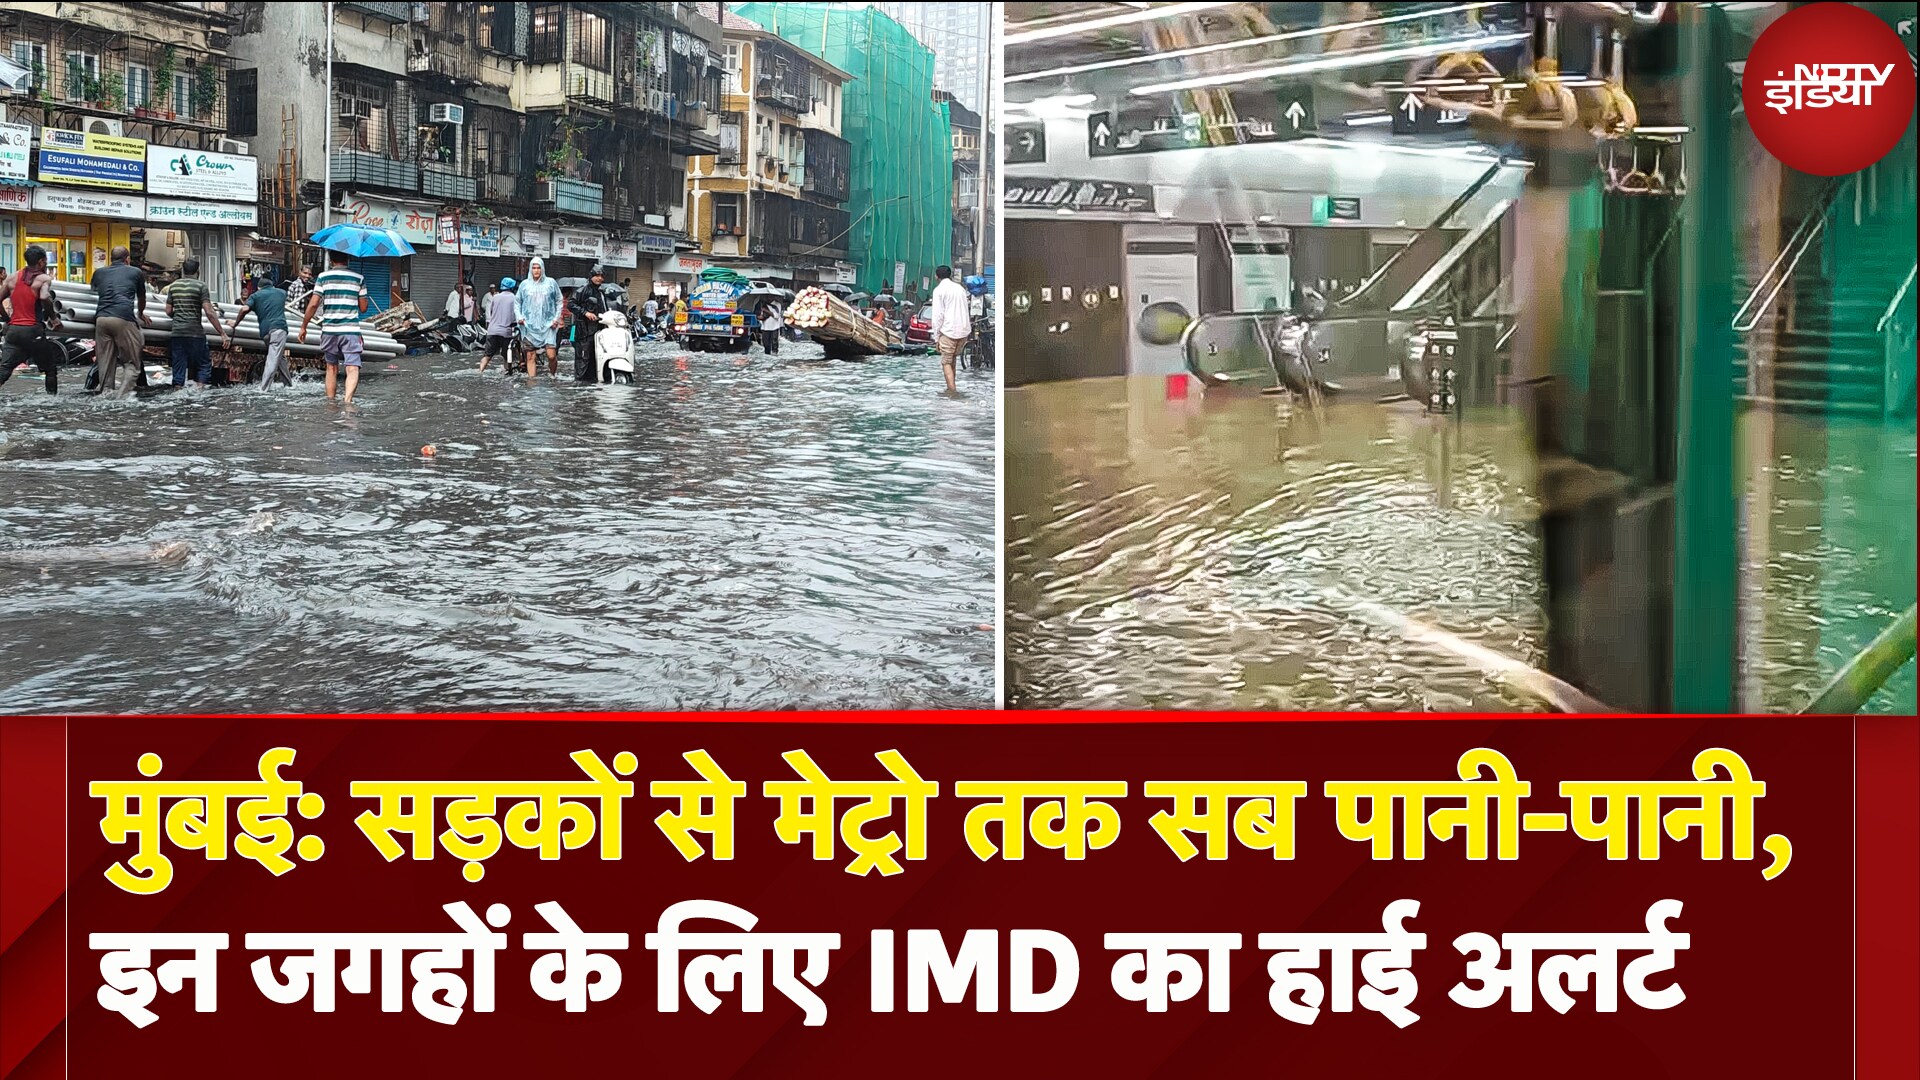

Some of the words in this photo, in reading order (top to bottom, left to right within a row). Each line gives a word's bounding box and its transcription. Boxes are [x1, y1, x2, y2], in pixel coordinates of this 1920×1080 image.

[13, 134, 27, 147] Co.
[122, 163, 127, 171] &
[195, 154, 235, 171] Crown
[149, 206, 175, 216] क्राउन
[177, 205, 199, 217] स्टील
[200, 209, 217, 220] एन्ड
[349, 200, 384, 227] Rose
[405, 209, 434, 234] रोज़
